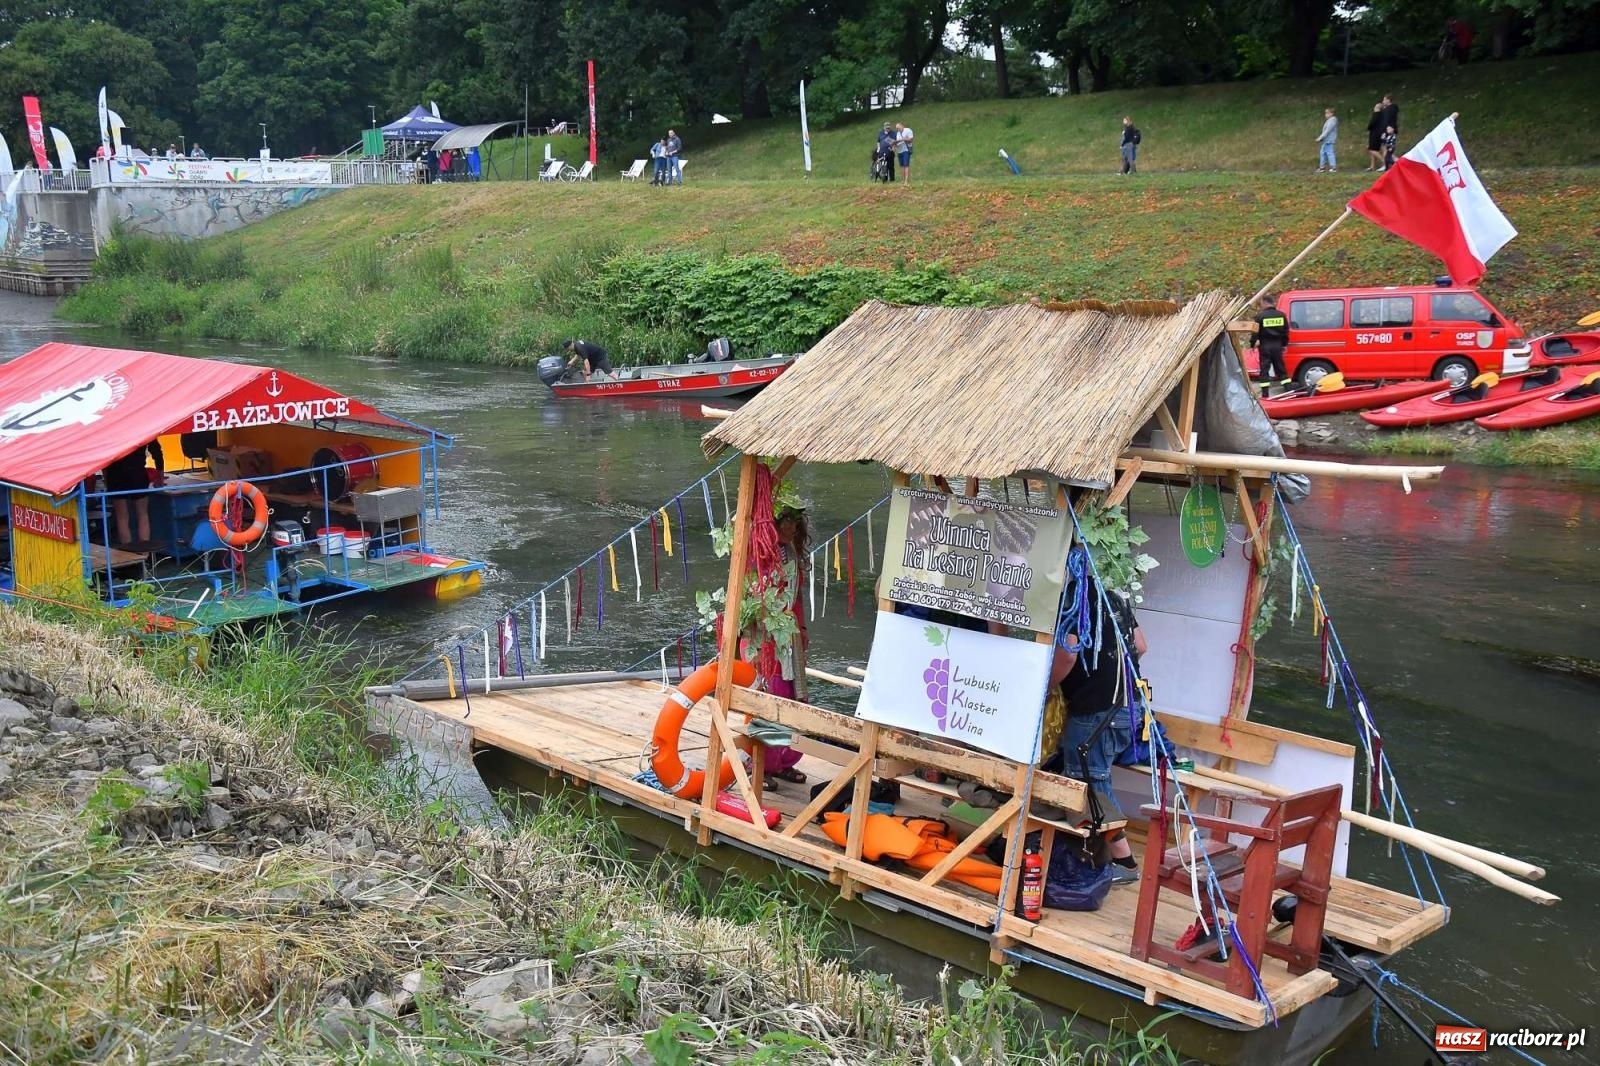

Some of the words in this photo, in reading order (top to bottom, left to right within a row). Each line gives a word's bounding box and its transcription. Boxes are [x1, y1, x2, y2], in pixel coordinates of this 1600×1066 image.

[1456, 332, 1475, 340] OSP
[192, 397, 350, 432] BŁAŻEJOWICE
[899, 488, 947, 502] agroturystyka
[975, 499, 1013, 512] tradycyjne
[1025, 507, 1058, 517] sadzonki
[929, 515, 991, 552] Winnica
[902, 540, 925, 569] Na
[927, 544, 978, 588] Leśnej
[980, 553, 1033, 590] Polanie
[894, 578, 921, 590] Proczki
[929, 585, 954, 596] Gmina
[955, 589, 976, 600] Zabór
[978, 595, 993, 606] woj.
[994, 598, 1026, 612] Lubuskie
[921, 596, 937, 605] 609
[938, 599, 951, 608] 179
[952, 601, 964, 610] 127
[985, 609, 999, 619] 785
[1000, 612, 1013, 622] 918
[1014, 614, 1031, 625] 042
[952, 665, 1000, 694] Lubuski
[951, 689, 998, 716] Klaster
[950, 711, 984, 737] Wina
